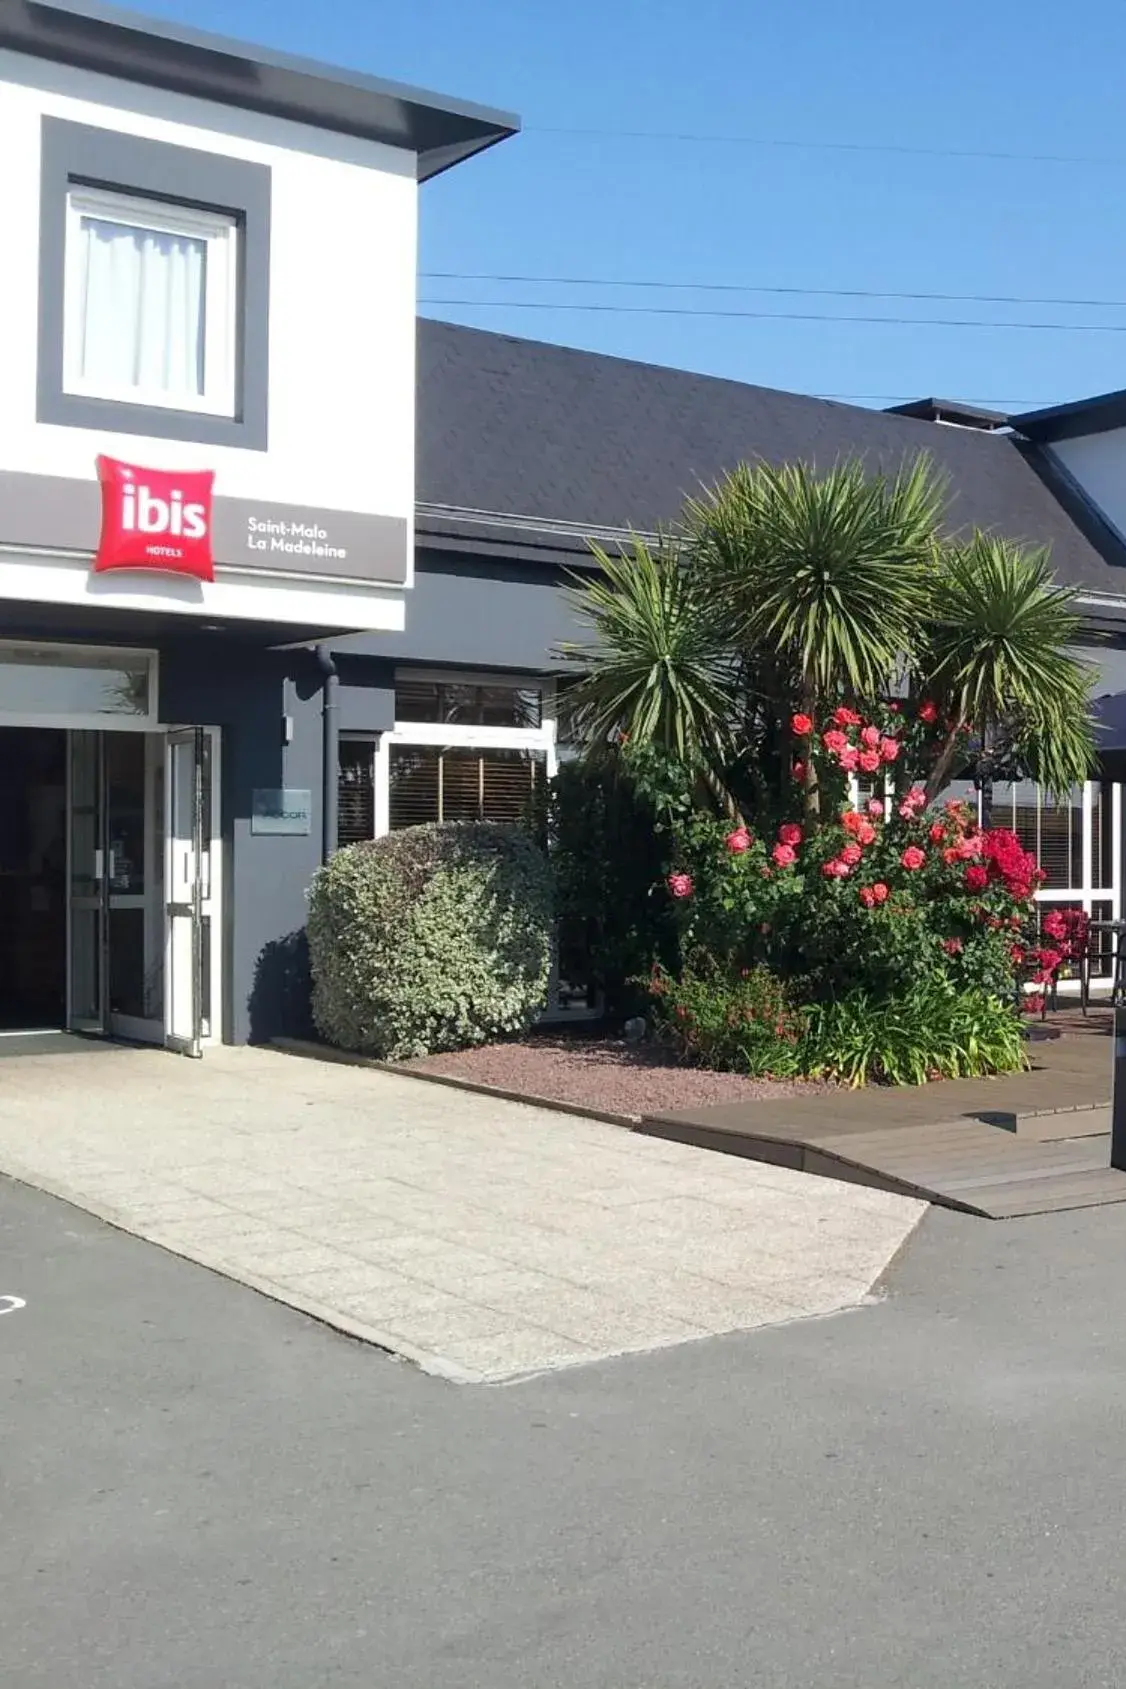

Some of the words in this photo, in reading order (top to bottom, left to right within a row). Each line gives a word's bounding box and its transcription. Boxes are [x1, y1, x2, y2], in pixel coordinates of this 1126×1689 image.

[122, 483, 207, 539] ibis
[247, 516, 328, 540] Saint-Malo
[145, 544, 183, 558] HOTELS
[247, 533, 267, 550] La
[270, 537, 347, 559] Madeleine
